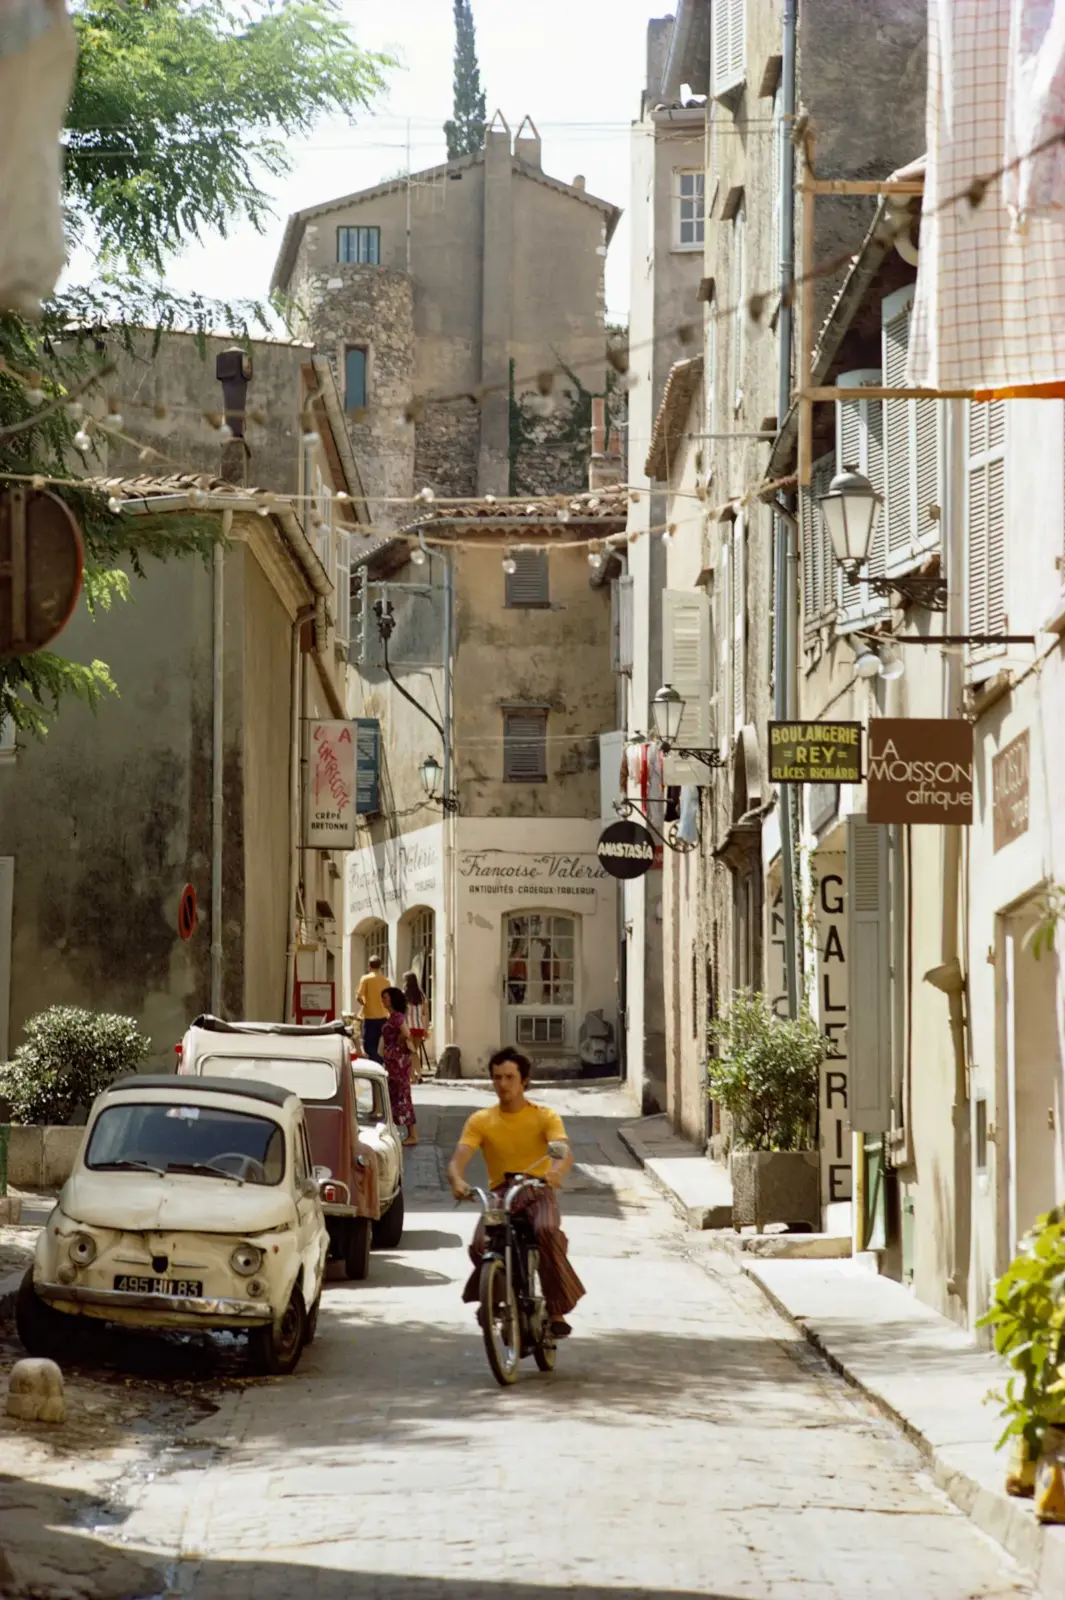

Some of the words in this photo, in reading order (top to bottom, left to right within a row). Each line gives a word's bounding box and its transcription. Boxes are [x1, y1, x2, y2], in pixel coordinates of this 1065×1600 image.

[771, 725, 858, 745] BOULANGERIE
[796, 746, 836, 763] REY
[868, 738, 900, 760] LA
[867, 760, 972, 783] MOISSON
[906, 781, 972, 811] afrique
[315, 811, 341, 820] CRÊPE
[311, 822, 348, 831] BRETONNE
[469, 883, 514, 894] ANTIQUITÉS
[518, 884, 553, 894] CADEAUX
[557, 885, 596, 895] TABLEAUX
[821, 874, 852, 1202] GALERIE
[118, 1276, 149, 1293] 495
[177, 1280, 198, 1298] 83
